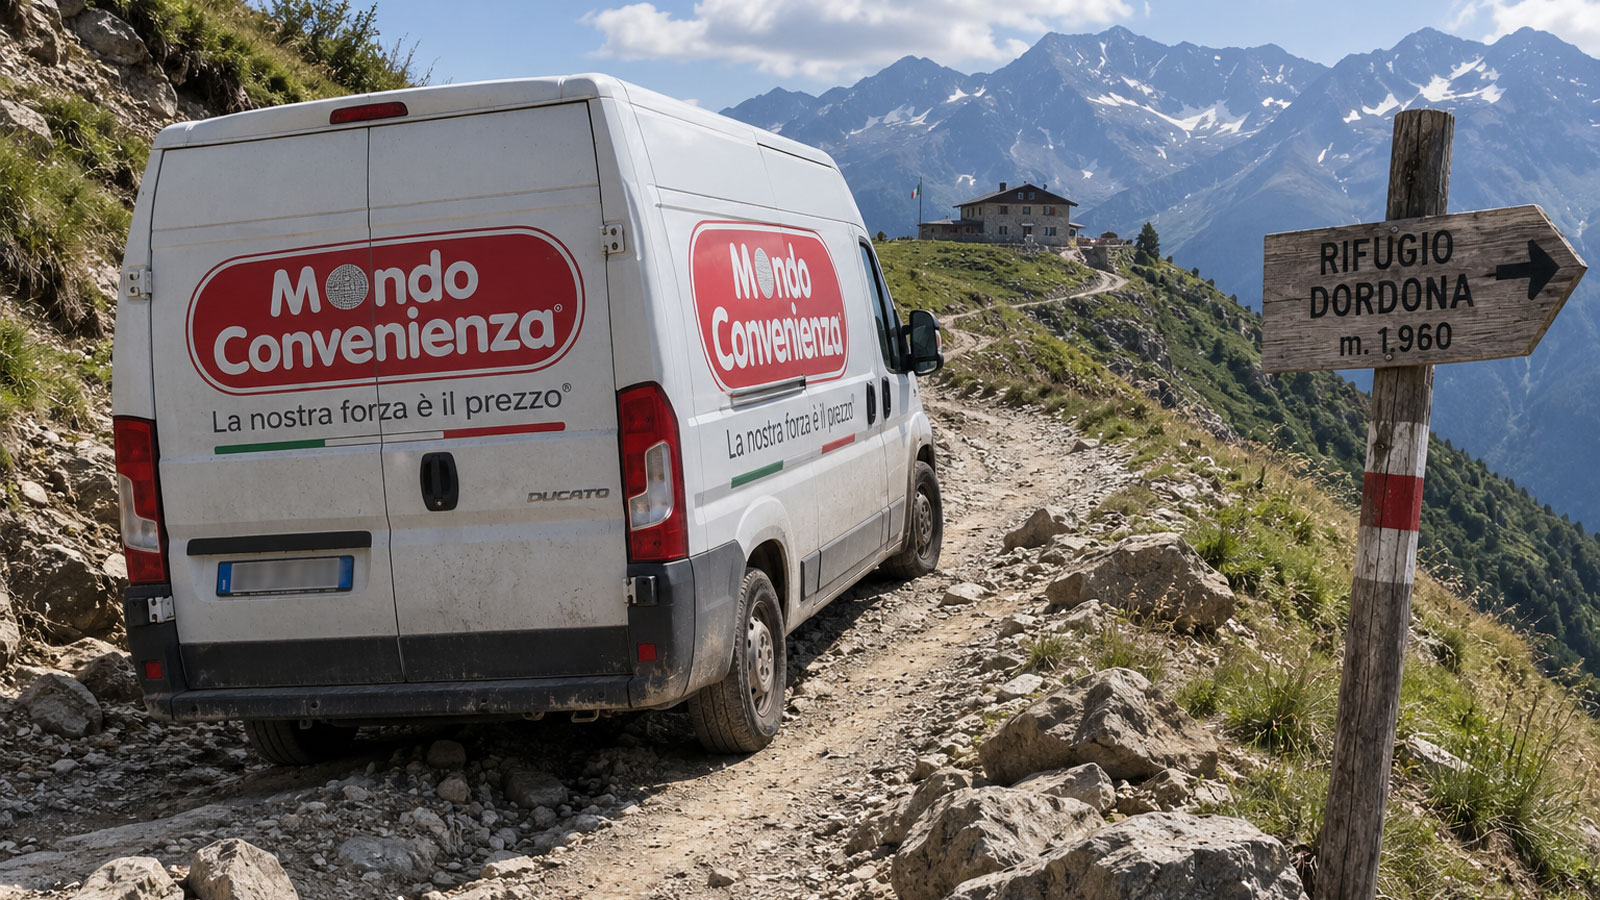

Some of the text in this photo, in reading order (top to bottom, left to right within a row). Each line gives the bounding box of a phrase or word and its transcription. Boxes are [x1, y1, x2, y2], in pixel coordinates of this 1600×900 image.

[1320, 229, 1454, 275] RIFUGIO
[1309, 273, 1475, 319] DORDONA
[213, 306, 556, 375] Convenienza
[711, 301, 844, 372] Convenienza
[1339, 321, 1452, 356] m. 1.960
[212, 410, 242, 433] La
[250, 404, 333, 430] nostra
[340, 398, 408, 424] forza
[416, 393, 433, 417] è
[442, 391, 455, 416] il
[726, 429, 744, 459] La
[746, 420, 784, 454] nostra
[785, 412, 811, 440] forza
[812, 404, 819, 431] è
[820, 402, 826, 429] il
[526, 487, 610, 503] DUCATO
